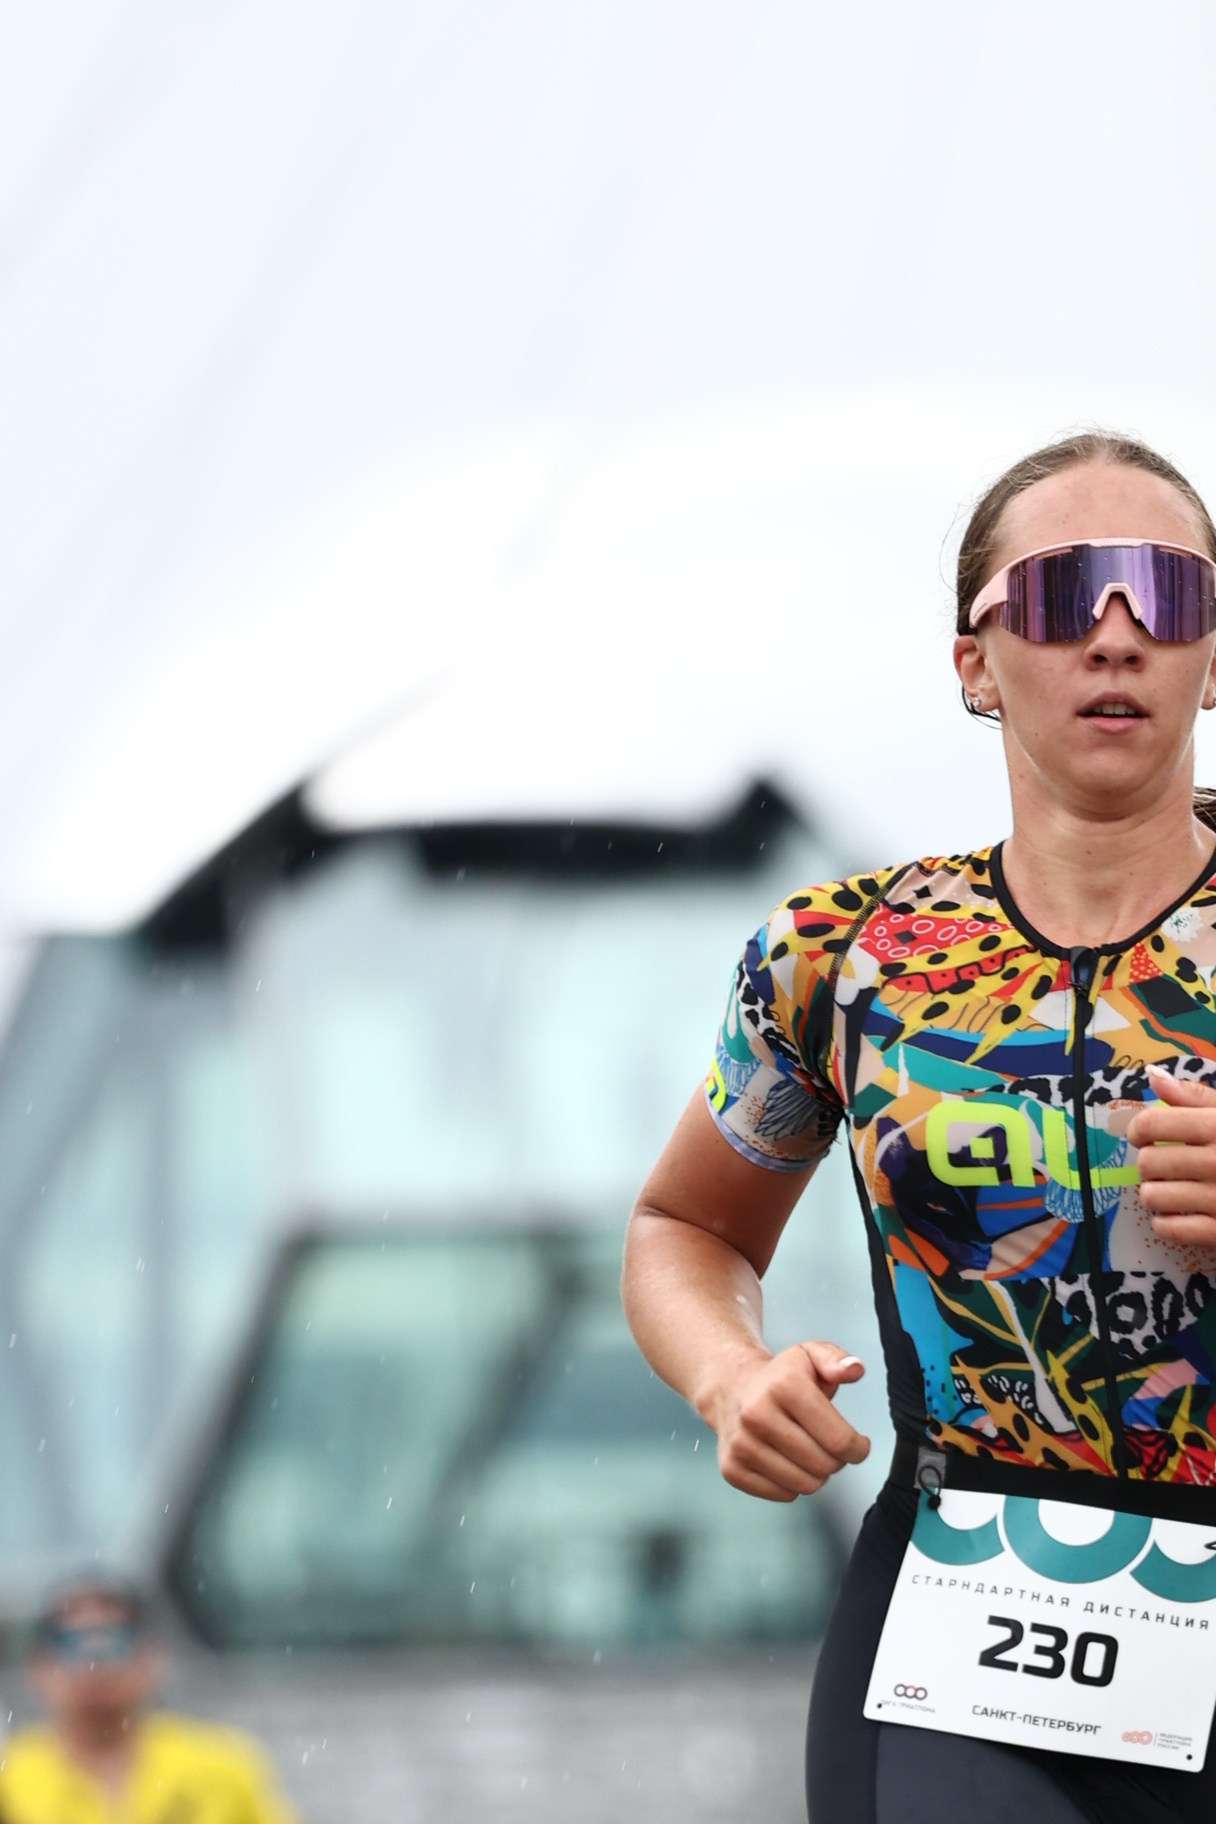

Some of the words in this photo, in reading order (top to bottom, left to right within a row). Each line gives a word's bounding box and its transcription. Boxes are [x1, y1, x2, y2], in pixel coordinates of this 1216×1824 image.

[911, 1574, 1071, 1608] СТАРНДАРТНАЯ
[1083, 1601, 1210, 1631] ДИСТАНЦИЯ
[978, 1614, 1119, 1688] 230
[971, 1704, 1102, 1735] САНКТ-ПЕТЕРБУРГ
